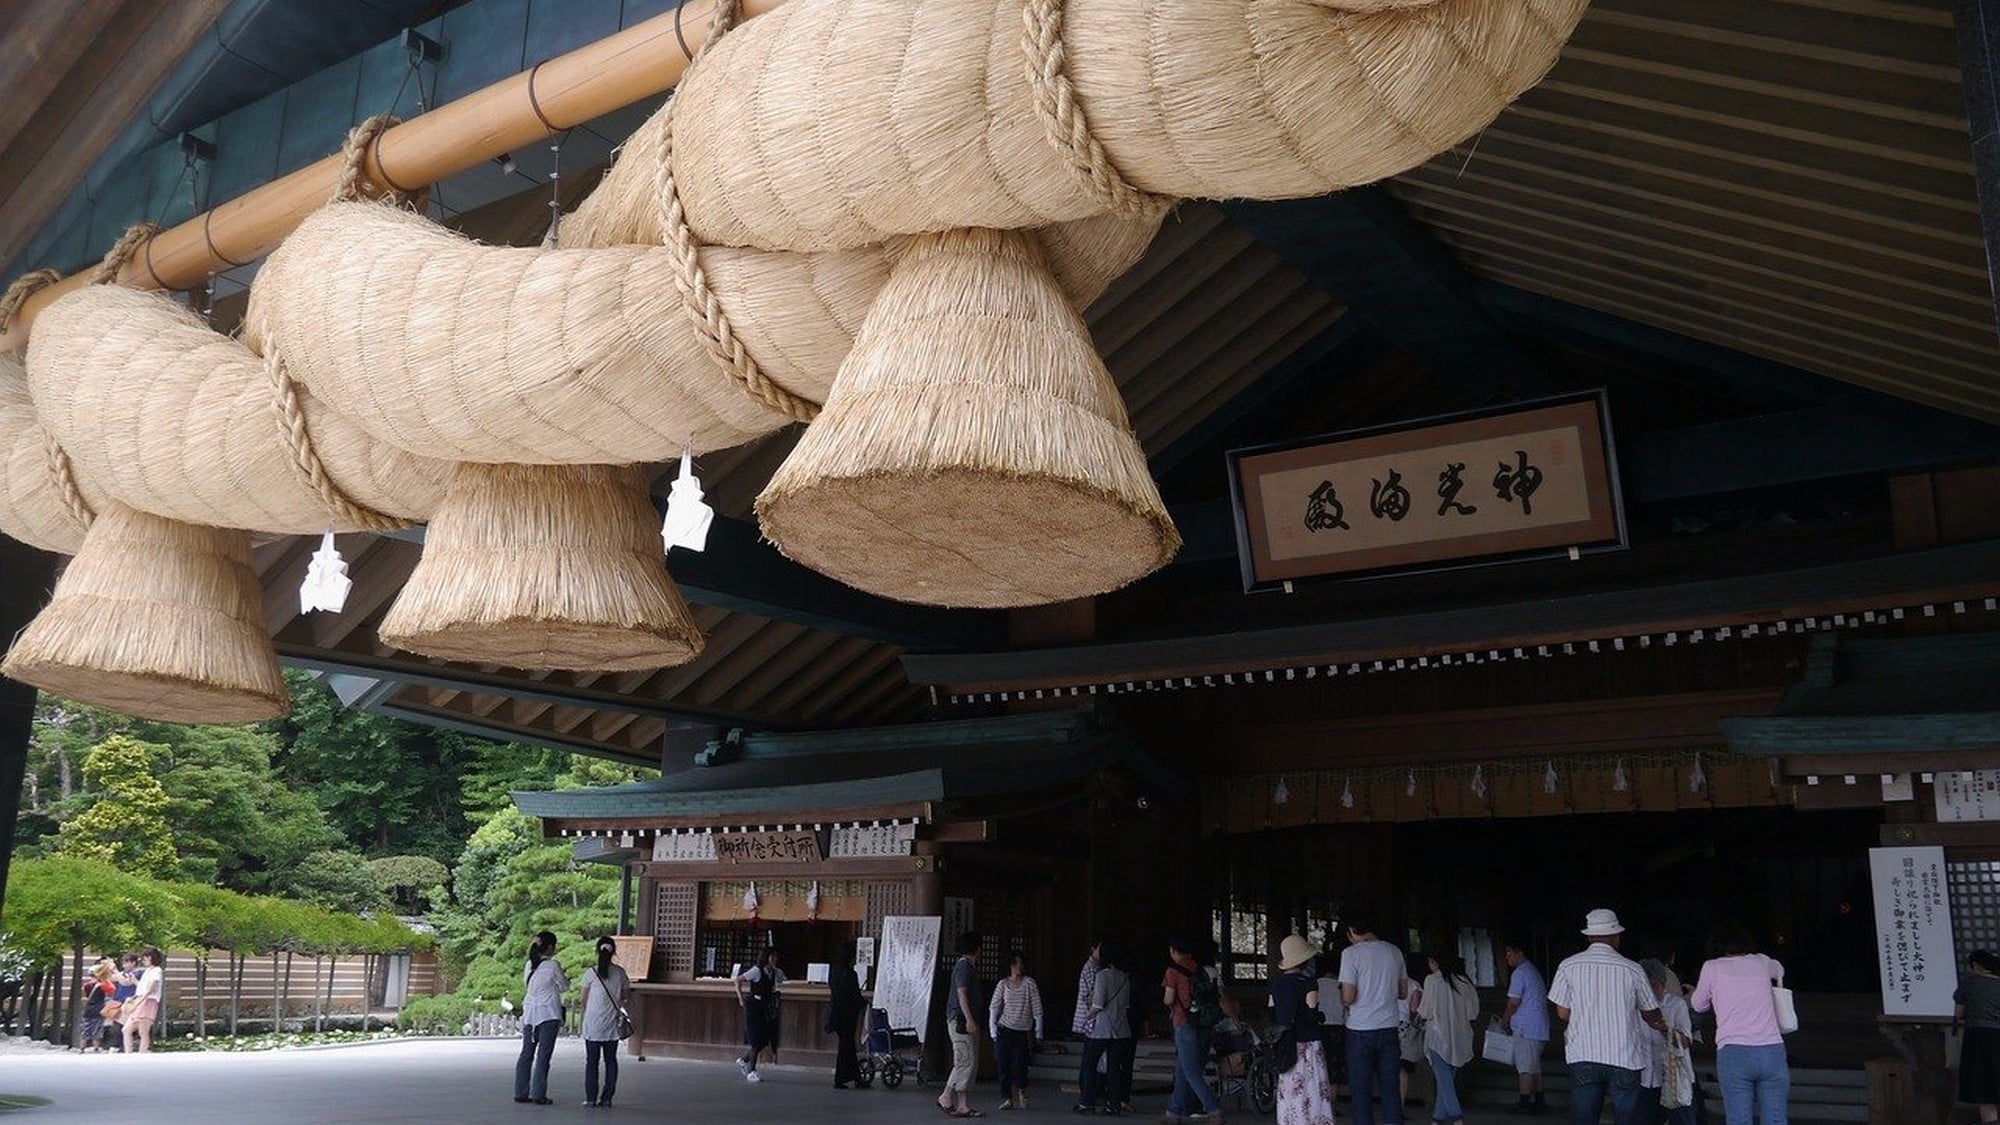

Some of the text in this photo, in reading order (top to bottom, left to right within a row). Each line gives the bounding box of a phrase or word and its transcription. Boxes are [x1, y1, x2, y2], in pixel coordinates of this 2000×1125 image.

[717, 835, 814, 859] 御祈念受付所
